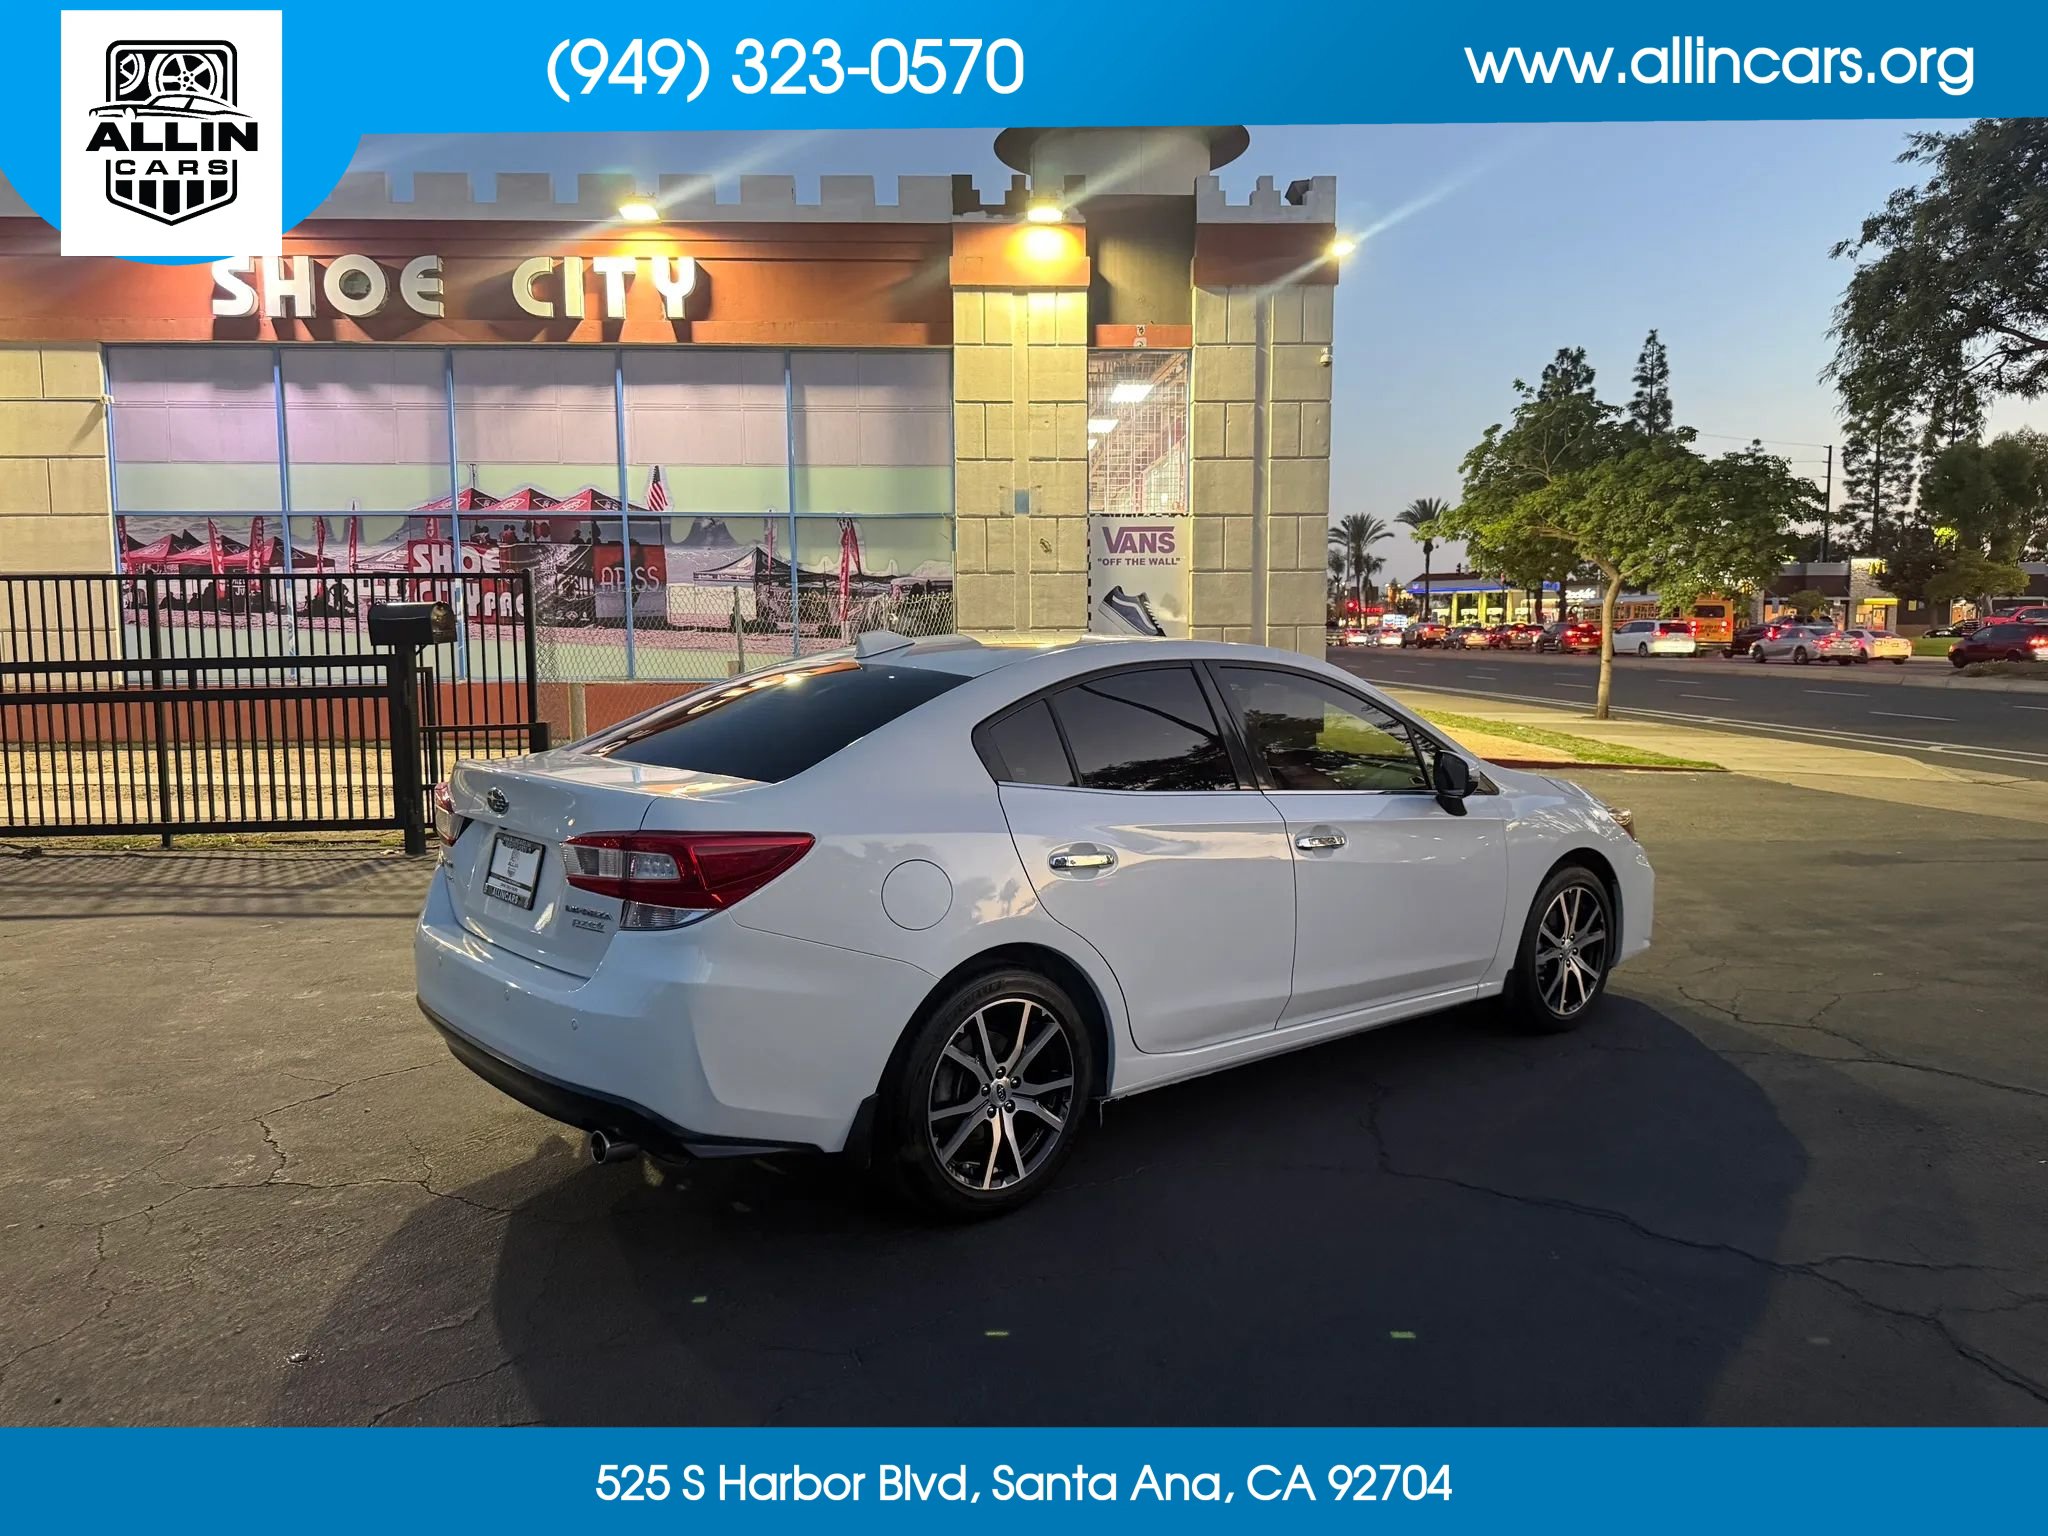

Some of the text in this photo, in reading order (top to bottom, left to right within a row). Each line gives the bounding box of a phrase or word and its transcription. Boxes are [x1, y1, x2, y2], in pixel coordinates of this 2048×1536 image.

[211, 254, 695, 319] SHOE CITY
[1102, 526, 1176, 554] VANS
[412, 543, 501, 574] SHOE
[1097, 557, 1181, 567] "OFF THE WALL"
